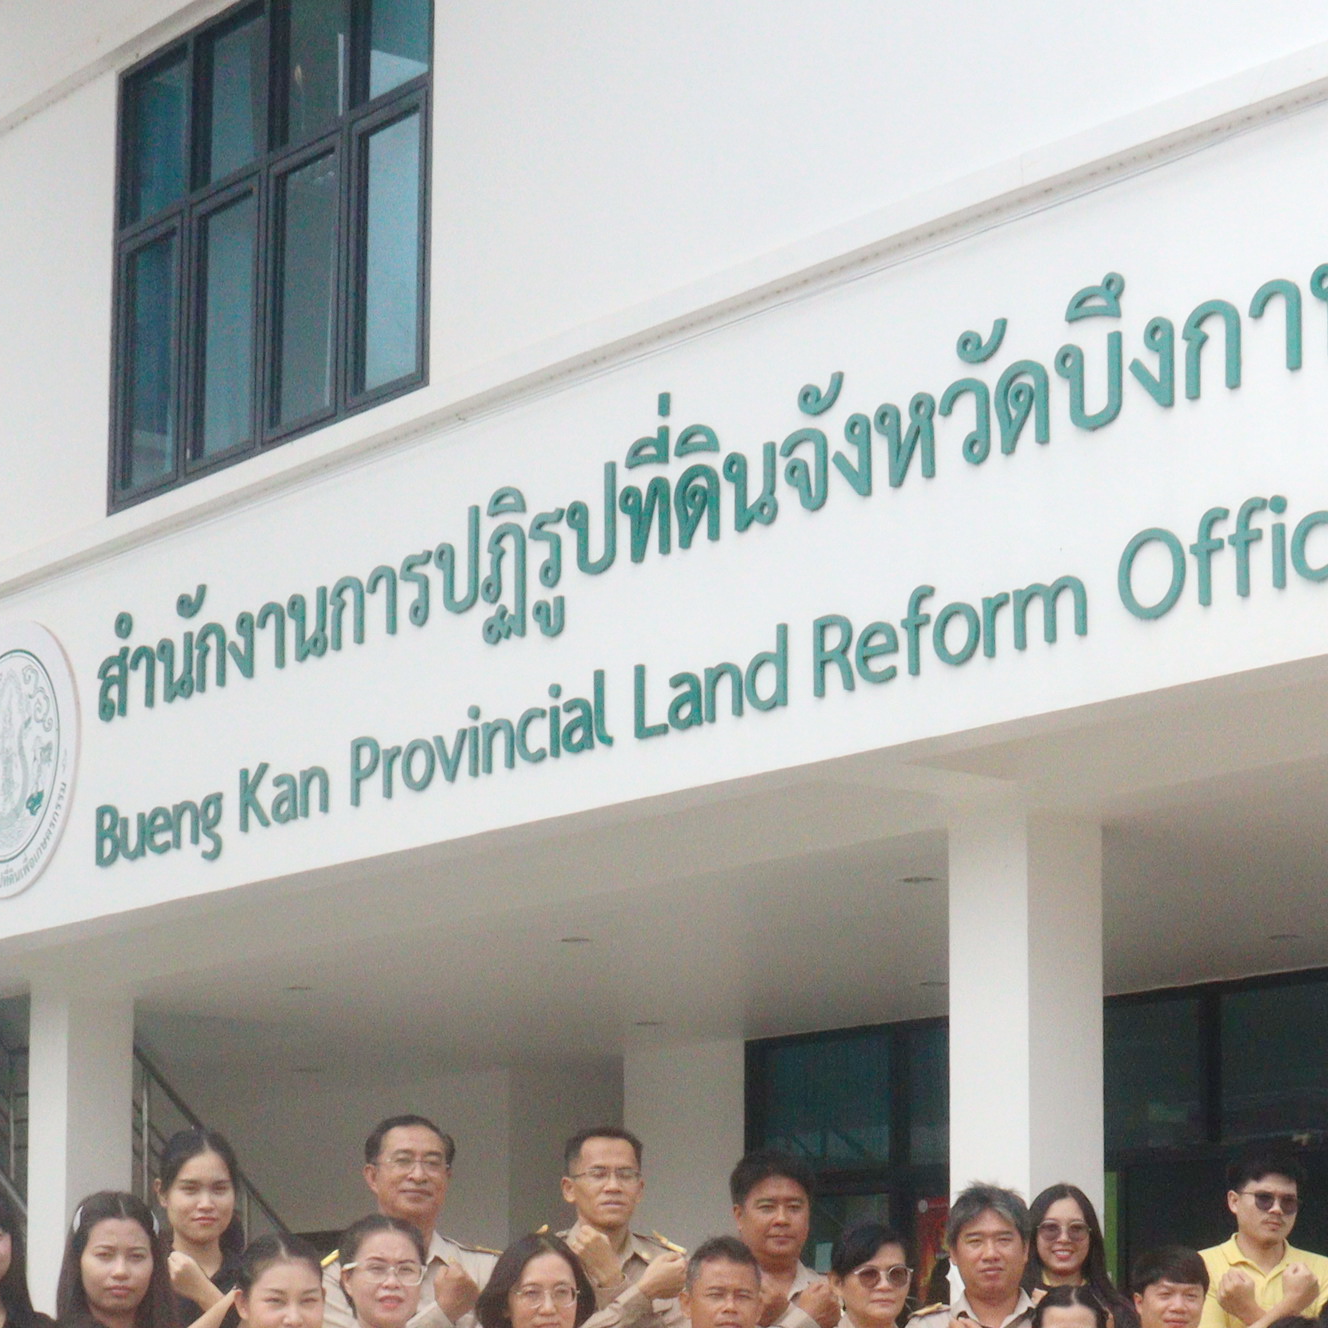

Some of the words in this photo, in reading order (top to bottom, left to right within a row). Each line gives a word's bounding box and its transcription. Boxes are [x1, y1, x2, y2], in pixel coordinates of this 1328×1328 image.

[95, 790, 224, 868] Bueng
[237, 761, 329, 831] Kan
[349, 669, 614, 807] Provincial
[635, 624, 789, 739] Land
[812, 575, 1087, 697] Reform
